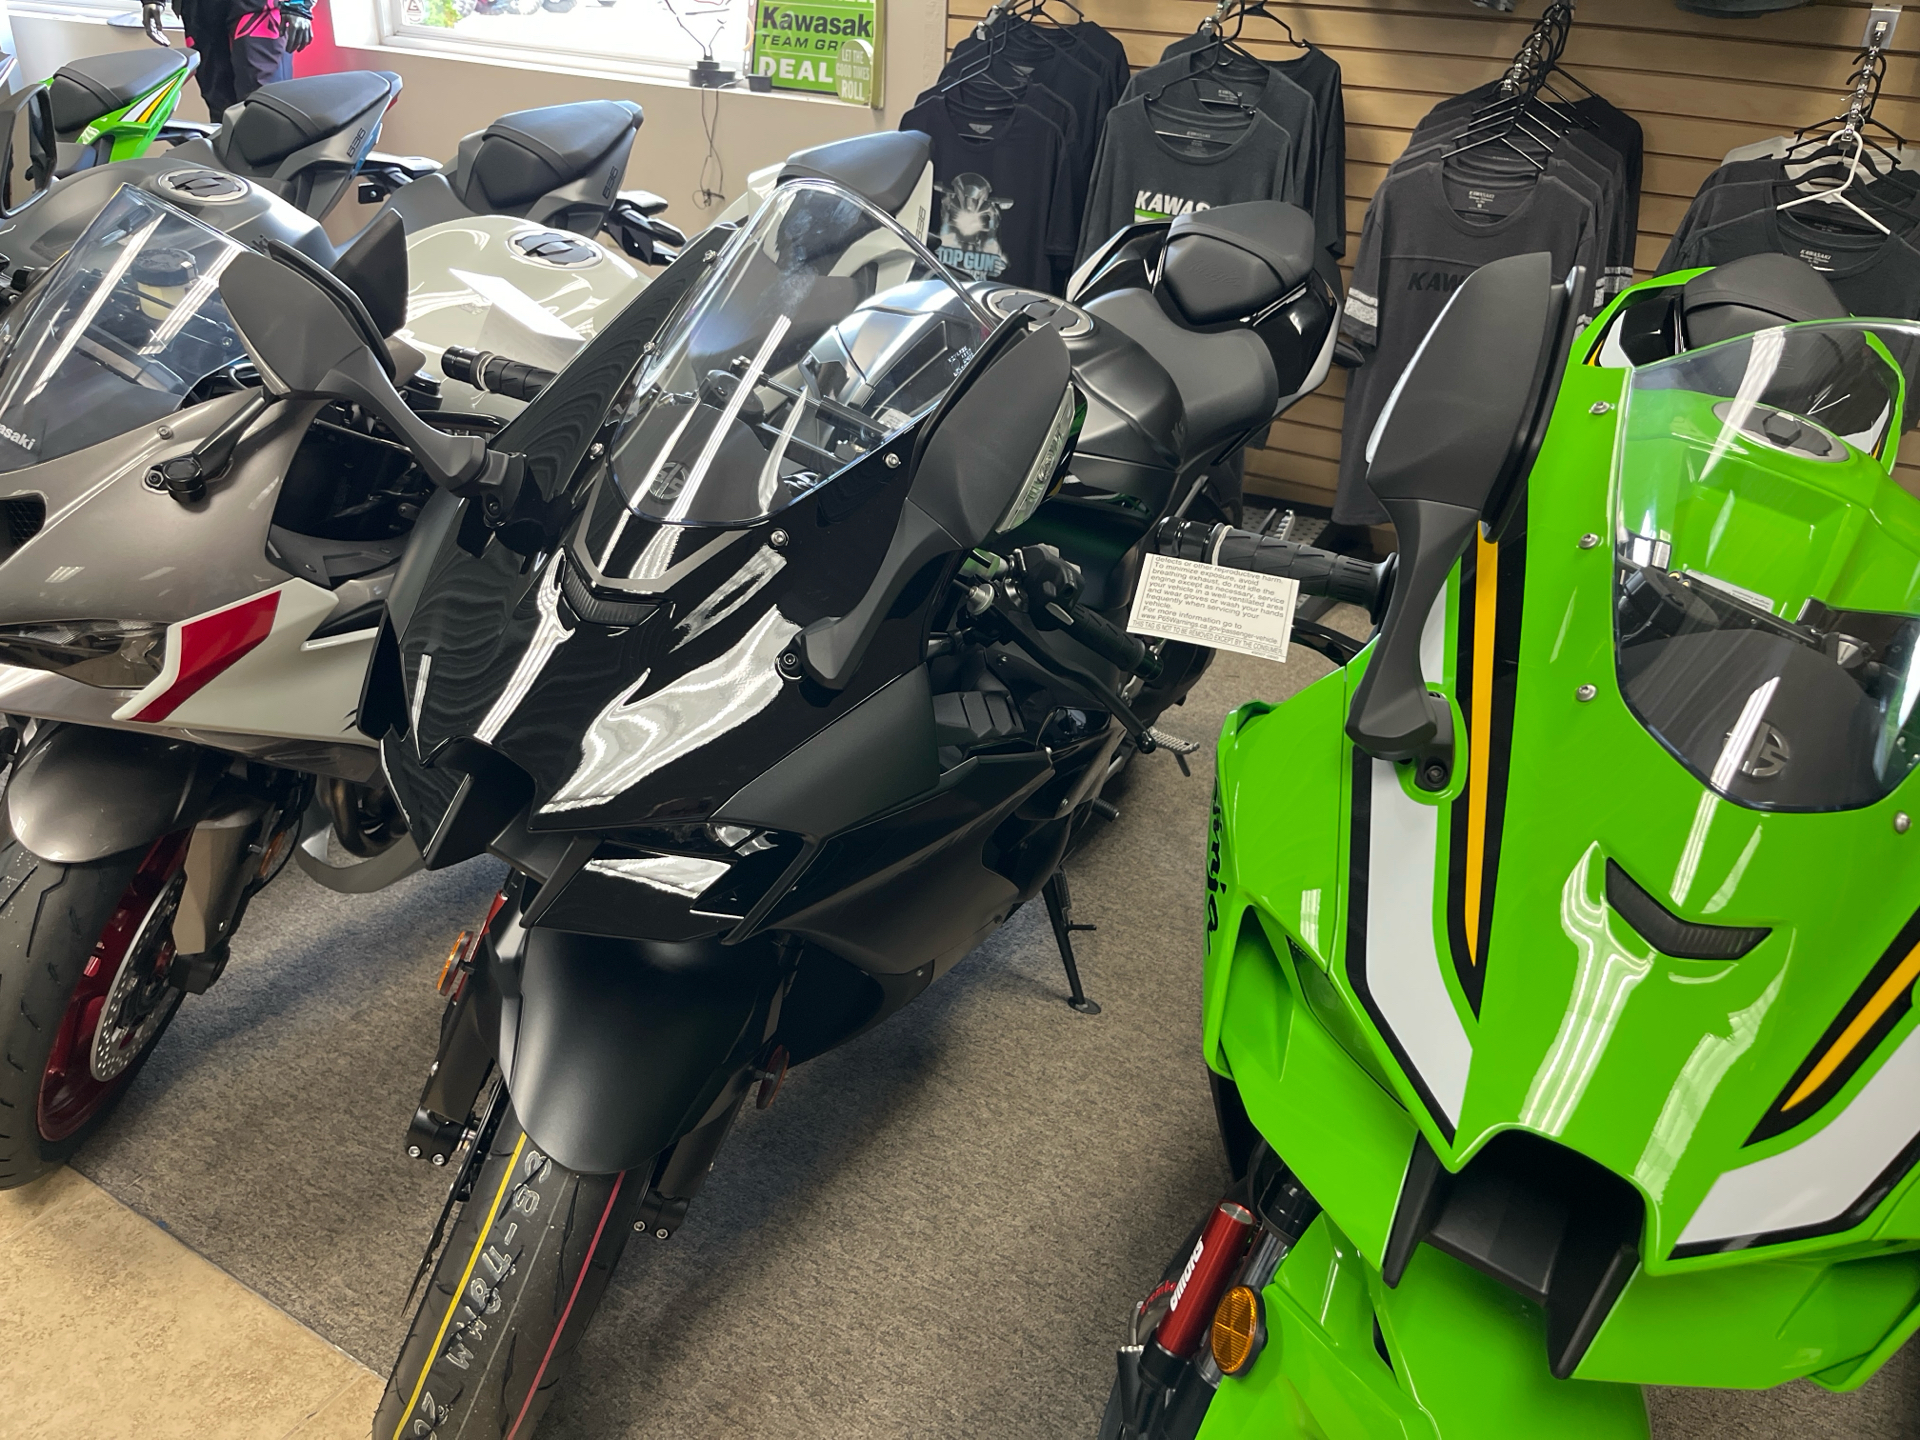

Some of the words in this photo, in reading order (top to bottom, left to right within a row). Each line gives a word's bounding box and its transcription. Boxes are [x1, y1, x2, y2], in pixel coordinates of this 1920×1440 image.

[763, 6, 873, 38] Kawasak
[762, 34, 809, 49] TEAM
[815, 39, 845, 52] GR
[841, 49, 852, 62] LET
[853, 50, 865, 65] THE
[836, 62, 852, 78] GOOD
[853, 65, 870, 81] TIMES
[841, 79, 865, 101] ROLL
[963, 251, 995, 272] GUN
[1151, 568, 1187, 579] breathing
[1155, 556, 1182, 565] defects
[1214, 567, 1260, 579] reproductive
[1165, 565, 1198, 574] minimize
[1150, 575, 1175, 583] engine
[1177, 579, 1202, 587] except
[1257, 594, 1284, 604] service
[1167, 584, 1193, 592] vehicle
[1211, 592, 1264, 606] well-ventilated
[1145, 592, 1183, 605] frequently
[1206, 604, 1240, 616] servicing
[1183, 593, 1208, 602] gloves
[1260, 608, 1283, 617] hands
[1178, 612, 1221, 624] information
[1188, 629, 1213, 639] REMOVED
[1213, 634, 1234, 643] EXCEPT
